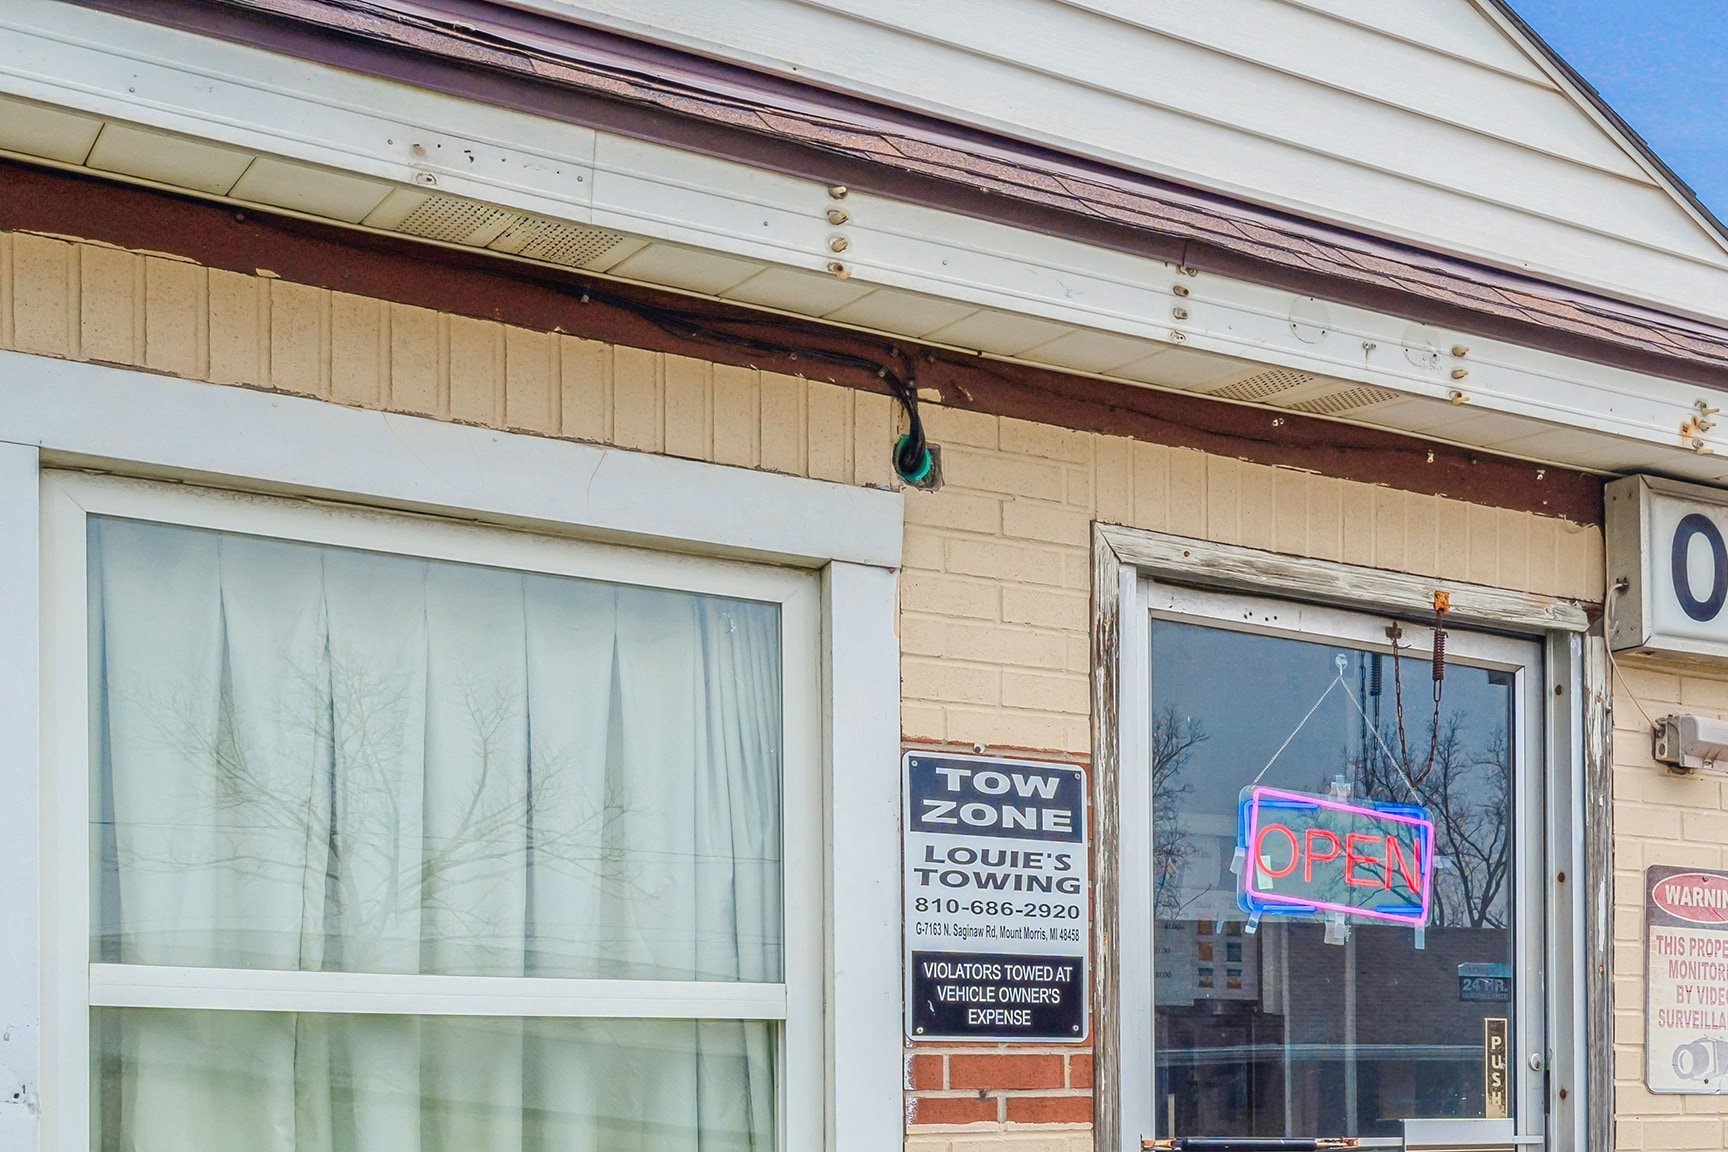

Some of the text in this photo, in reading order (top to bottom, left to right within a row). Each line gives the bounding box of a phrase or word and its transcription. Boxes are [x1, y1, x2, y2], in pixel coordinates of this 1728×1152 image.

[935, 767, 1060, 800] TOW
[921, 799, 1073, 833] ZONE
[924, 845, 1072, 872] LOUIE'S
[1255, 823, 1420, 893] OPEN
[913, 867, 1081, 895] TOWING
[914, 897, 1080, 920] 810-686-2920
[916, 922, 1079, 942] G-7163 N. Saginaw Rd, Mount Morris, MI 48458
[1656, 935, 1685, 956] THIS
[923, 962, 1073, 983] VIOLATORS TOWED AT
[937, 985, 1061, 1005] VEHICLE OWNER'S
[1462, 978, 1481, 991] 24
[1676, 985, 1693, 1004] BY
[967, 1009, 1032, 1026] EXPENSE
[1491, 1036, 1502, 1105] PUSH
